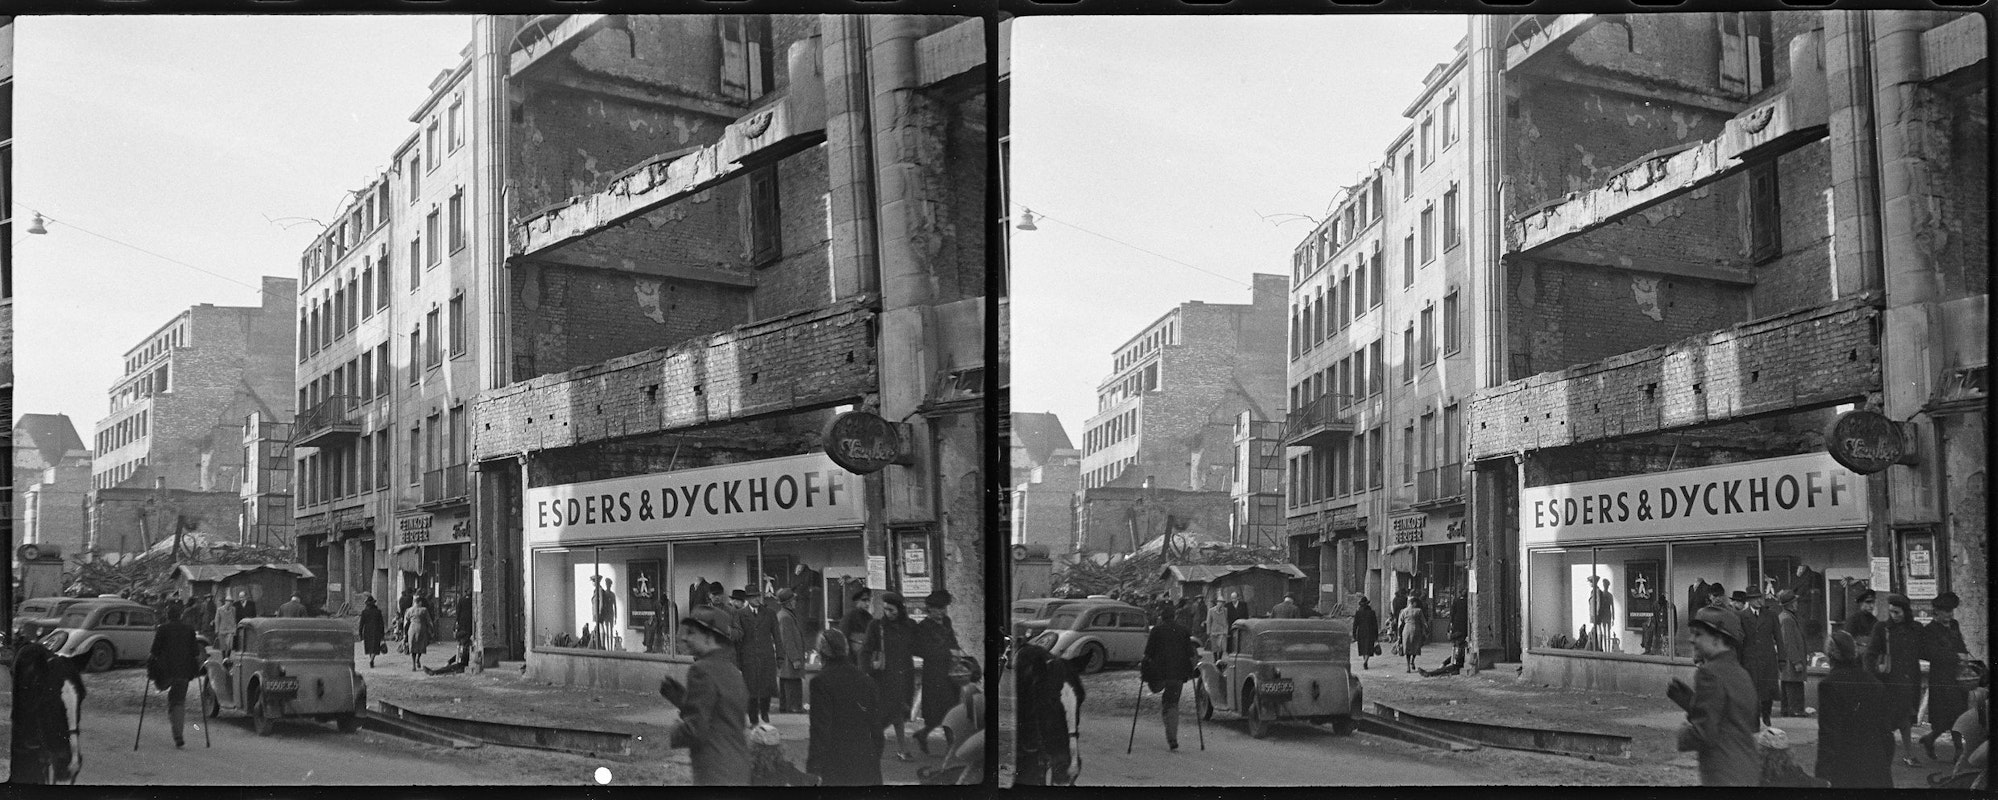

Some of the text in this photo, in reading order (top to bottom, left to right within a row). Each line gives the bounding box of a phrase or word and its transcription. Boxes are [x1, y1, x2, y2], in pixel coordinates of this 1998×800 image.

[538, 470, 844, 529] ESDERS & DYCKHOFF
[1534, 470, 1847, 529] ESDERS & DYCKHOFF
